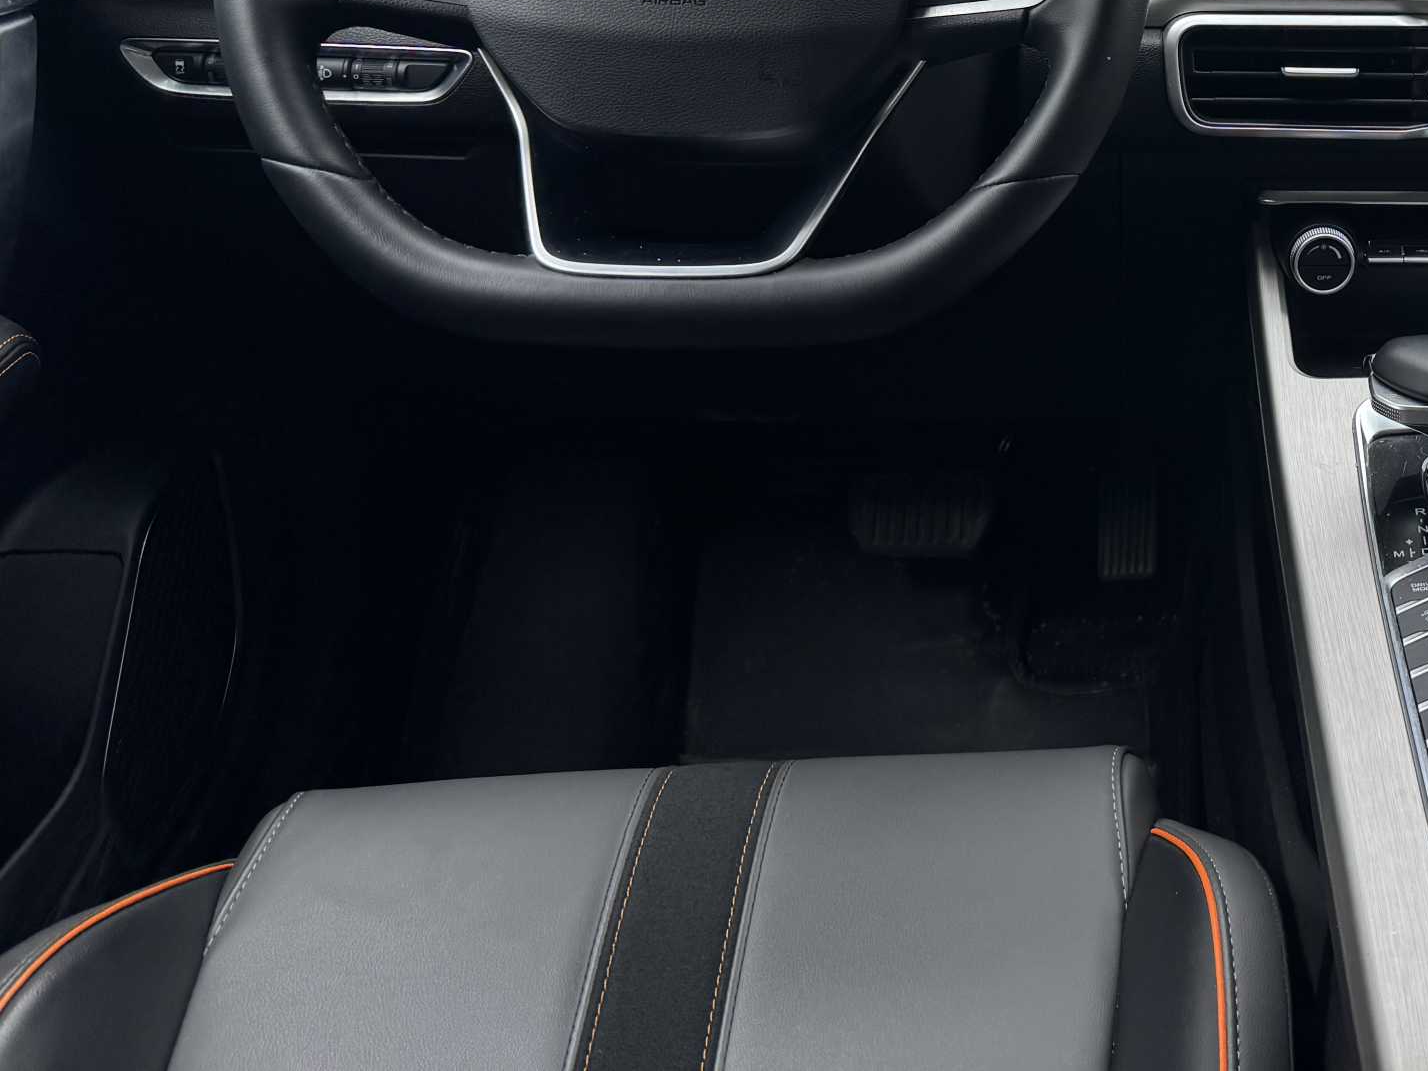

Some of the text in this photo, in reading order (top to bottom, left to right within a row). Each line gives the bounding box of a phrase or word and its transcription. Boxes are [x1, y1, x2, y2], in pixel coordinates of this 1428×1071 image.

[1415, 508, 1427, 516] R
[1417, 525, 1428, 533] N
[1393, 550, 1405, 558] M
